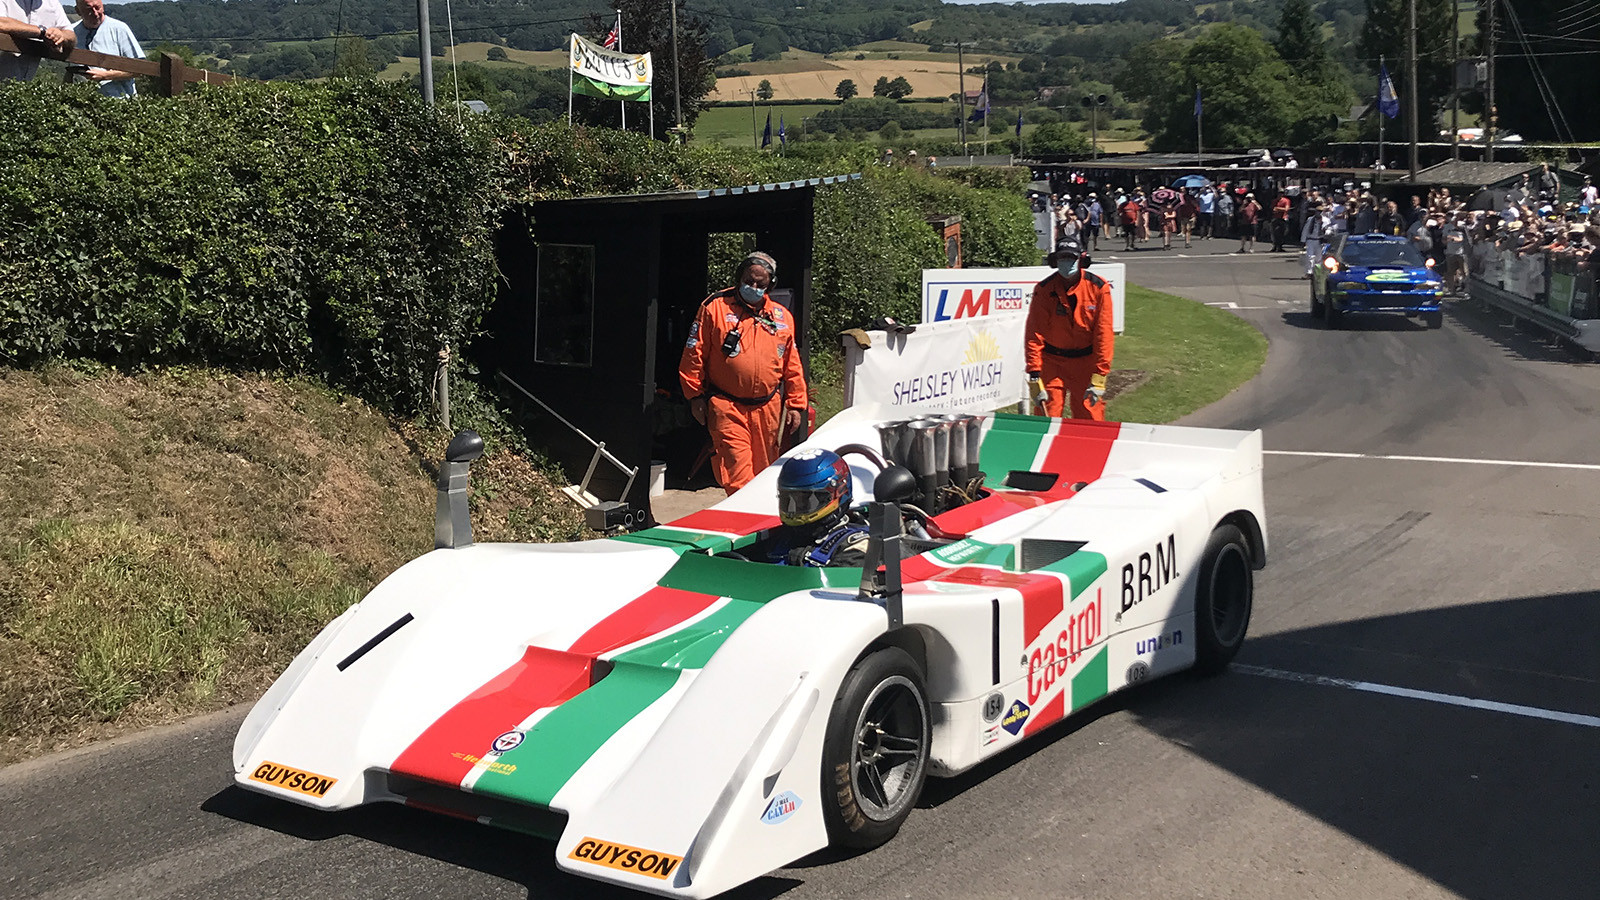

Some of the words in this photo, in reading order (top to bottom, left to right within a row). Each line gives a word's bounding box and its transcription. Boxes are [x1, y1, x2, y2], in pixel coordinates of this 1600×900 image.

[933, 288, 991, 322] LM
[996, 289, 1021, 299] LIQUI
[996, 300, 1021, 309] MOLY
[892, 370, 957, 405] SHELSLEY
[961, 362, 1003, 391] WALSH
[1121, 533, 1180, 614] B.R.M.
[1027, 587, 1101, 706] Castrol
[985, 696, 1002, 718] 154
[254, 763, 334, 795] GUYSON
[574, 840, 678, 876] GUYSON
